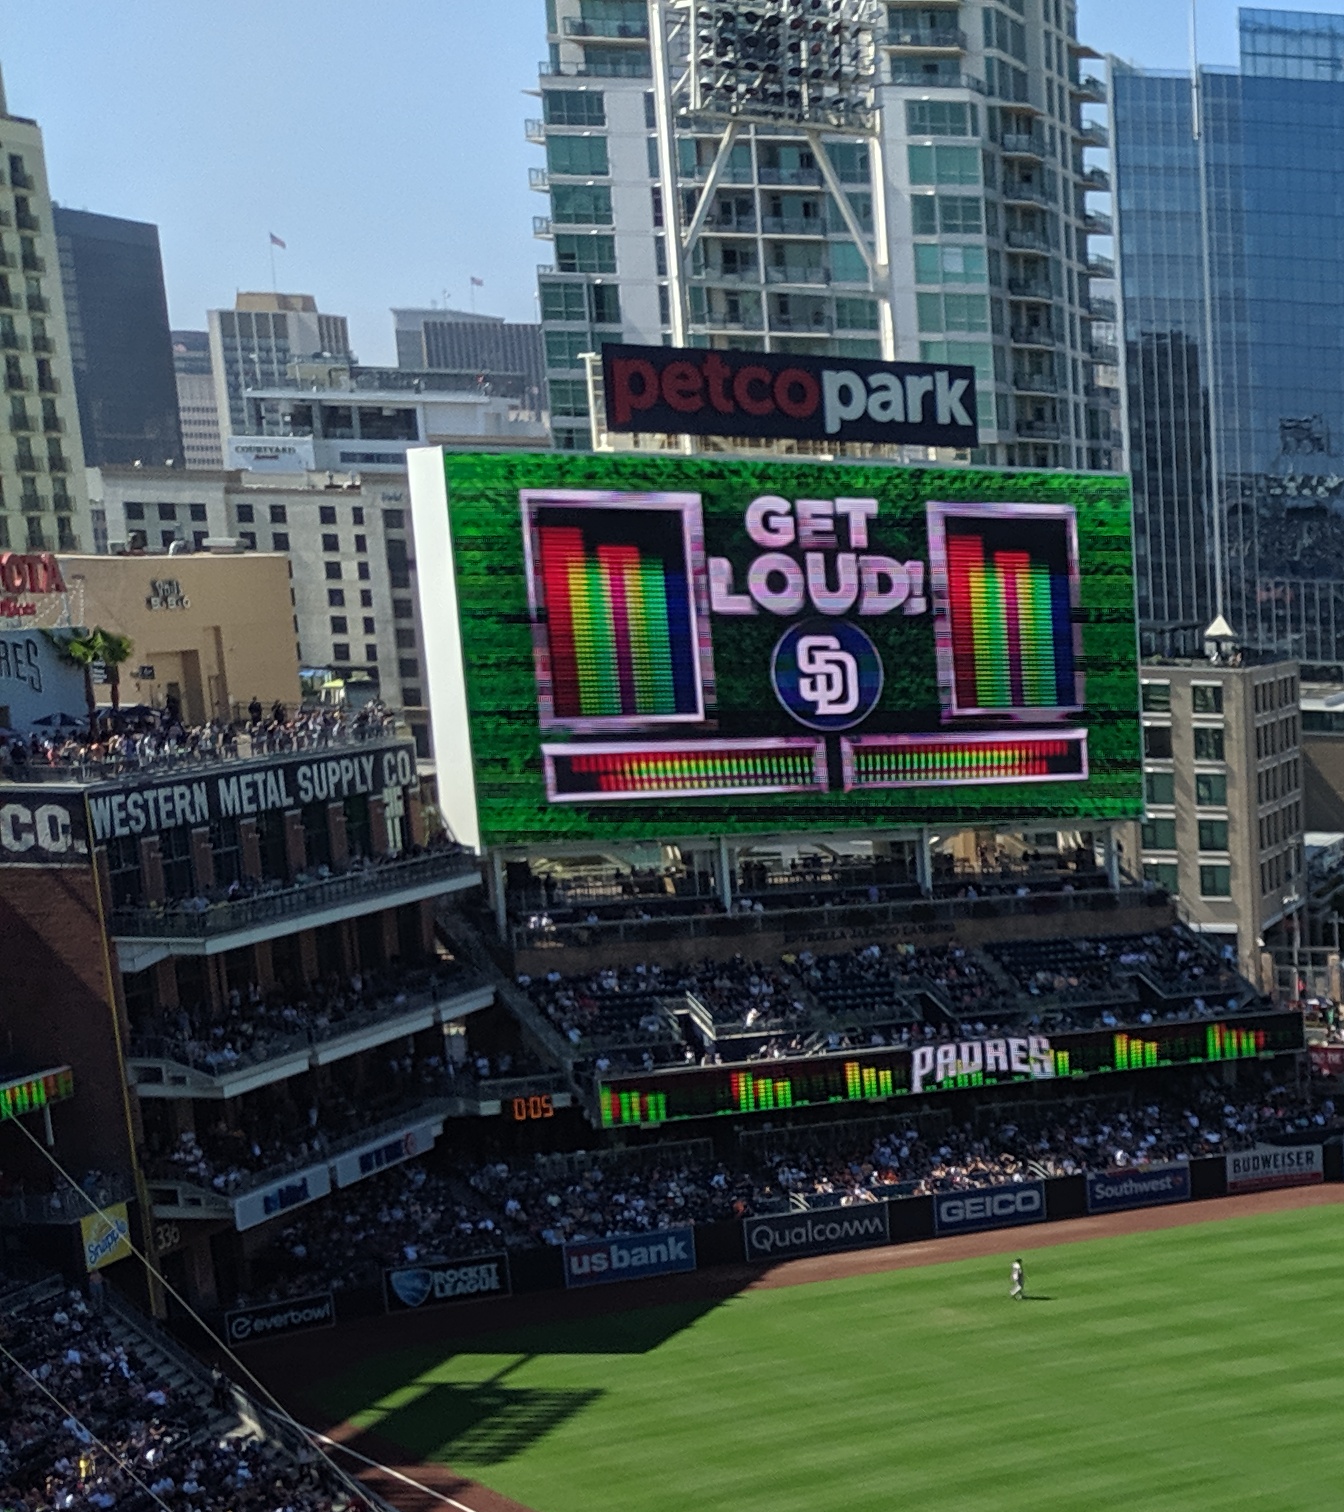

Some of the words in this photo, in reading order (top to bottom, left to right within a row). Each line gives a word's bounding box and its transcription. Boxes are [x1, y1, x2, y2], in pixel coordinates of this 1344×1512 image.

[745, 495, 879, 549] GET
[708, 552, 927, 615] LOUD!
[796, 635, 859, 716] SD
[90, 781, 209, 839] WESTERN
[218, 769, 294, 817] METAL
[299, 754, 374, 801] SUPPLY
[383, 750, 417, 787] CO.
[0, 803, 88, 855] CO.
[910, 1035, 1056, 1094] PADRES
[1232, 1149, 1315, 1175] BUDWEISER
[940, 1190, 1042, 1223] GEICO
[1095, 1176, 1173, 1200] Southwest
[434, 1263, 499, 1284] ROCKET
[434, 1276, 501, 1298] LEAGUE
[253, 1303, 331, 1332] everbowl
